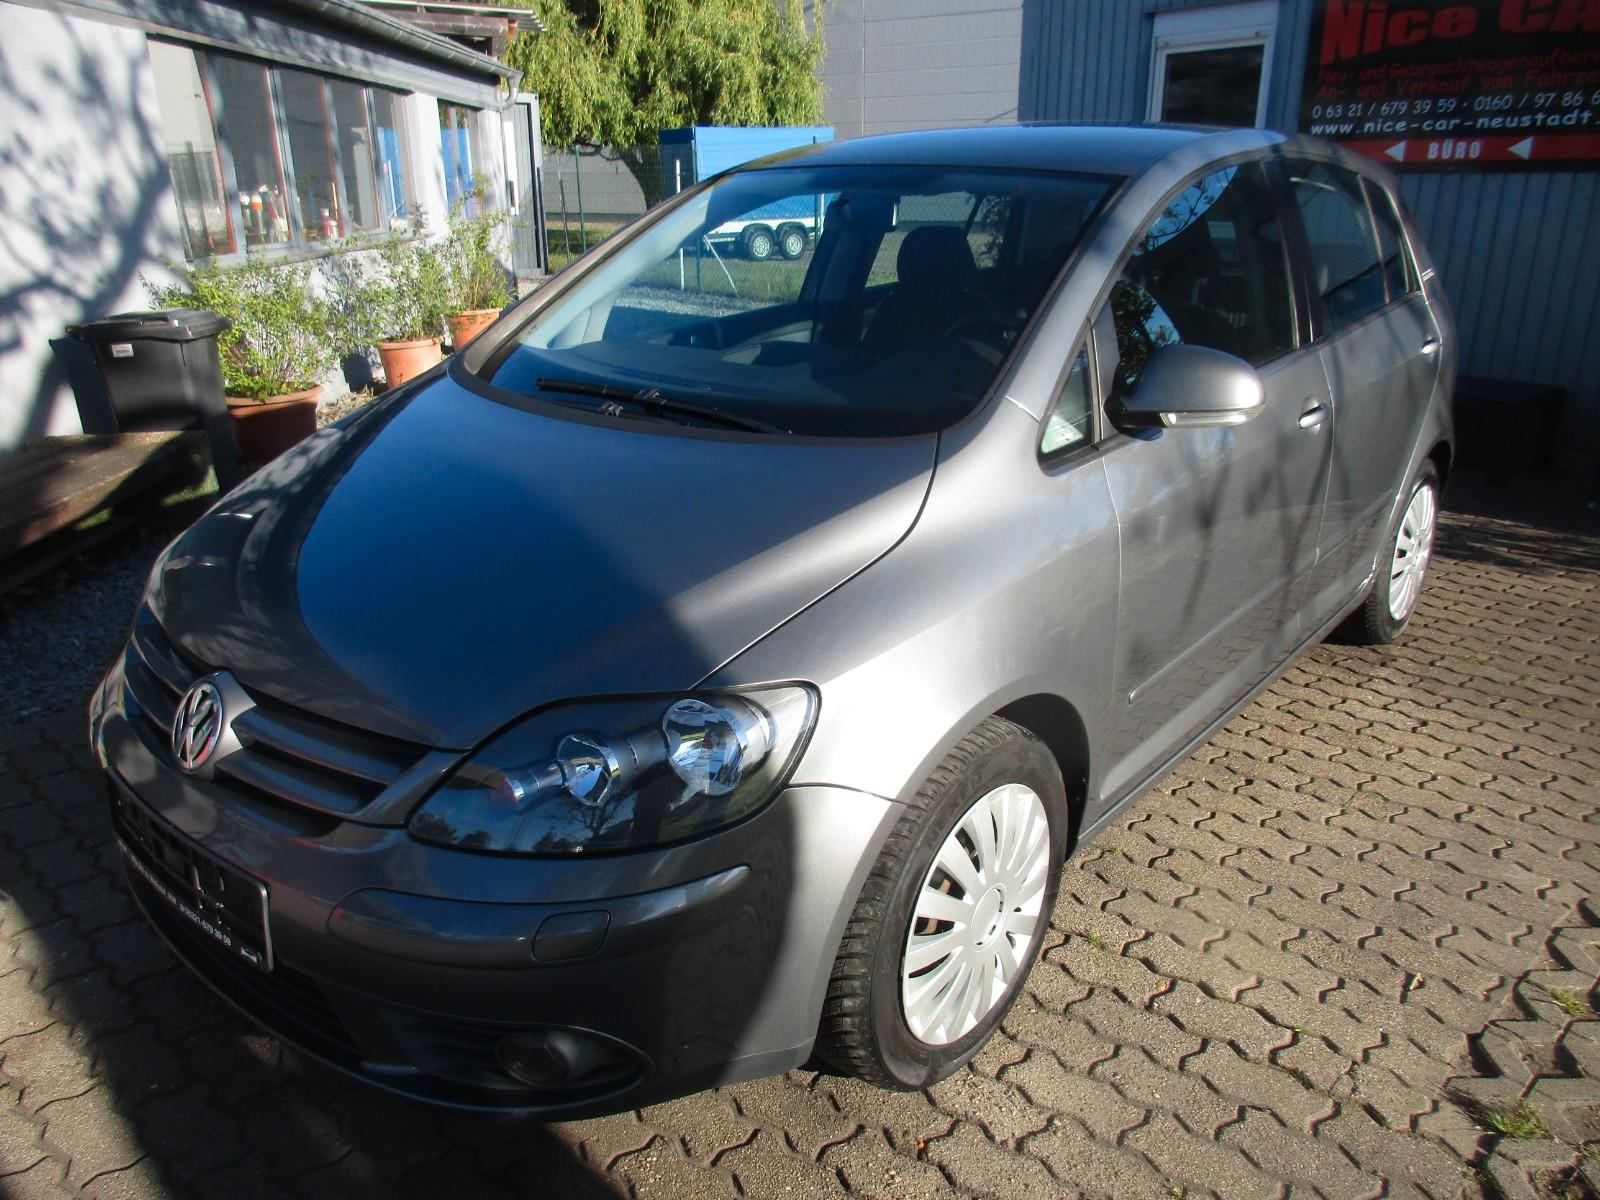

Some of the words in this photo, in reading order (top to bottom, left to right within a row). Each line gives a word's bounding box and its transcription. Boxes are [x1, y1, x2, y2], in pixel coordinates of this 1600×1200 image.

[1319, 0, 1478, 65] Nice
[1312, 105, 1322, 119] 0
[1326, 104, 1342, 118] 63
[1347, 102, 1362, 117] 21
[1367, 102, 1377, 116] /
[1380, 100, 1409, 116] 679
[1414, 99, 1432, 114] 39
[1437, 97, 1457, 113] 59
[1474, 94, 1513, 111] 0160
[1518, 92, 1529, 108] /
[1534, 92, 1557, 108] 97
[1561, 90, 1584, 107] 86
[1427, 138, 1482, 160] BÜRO
